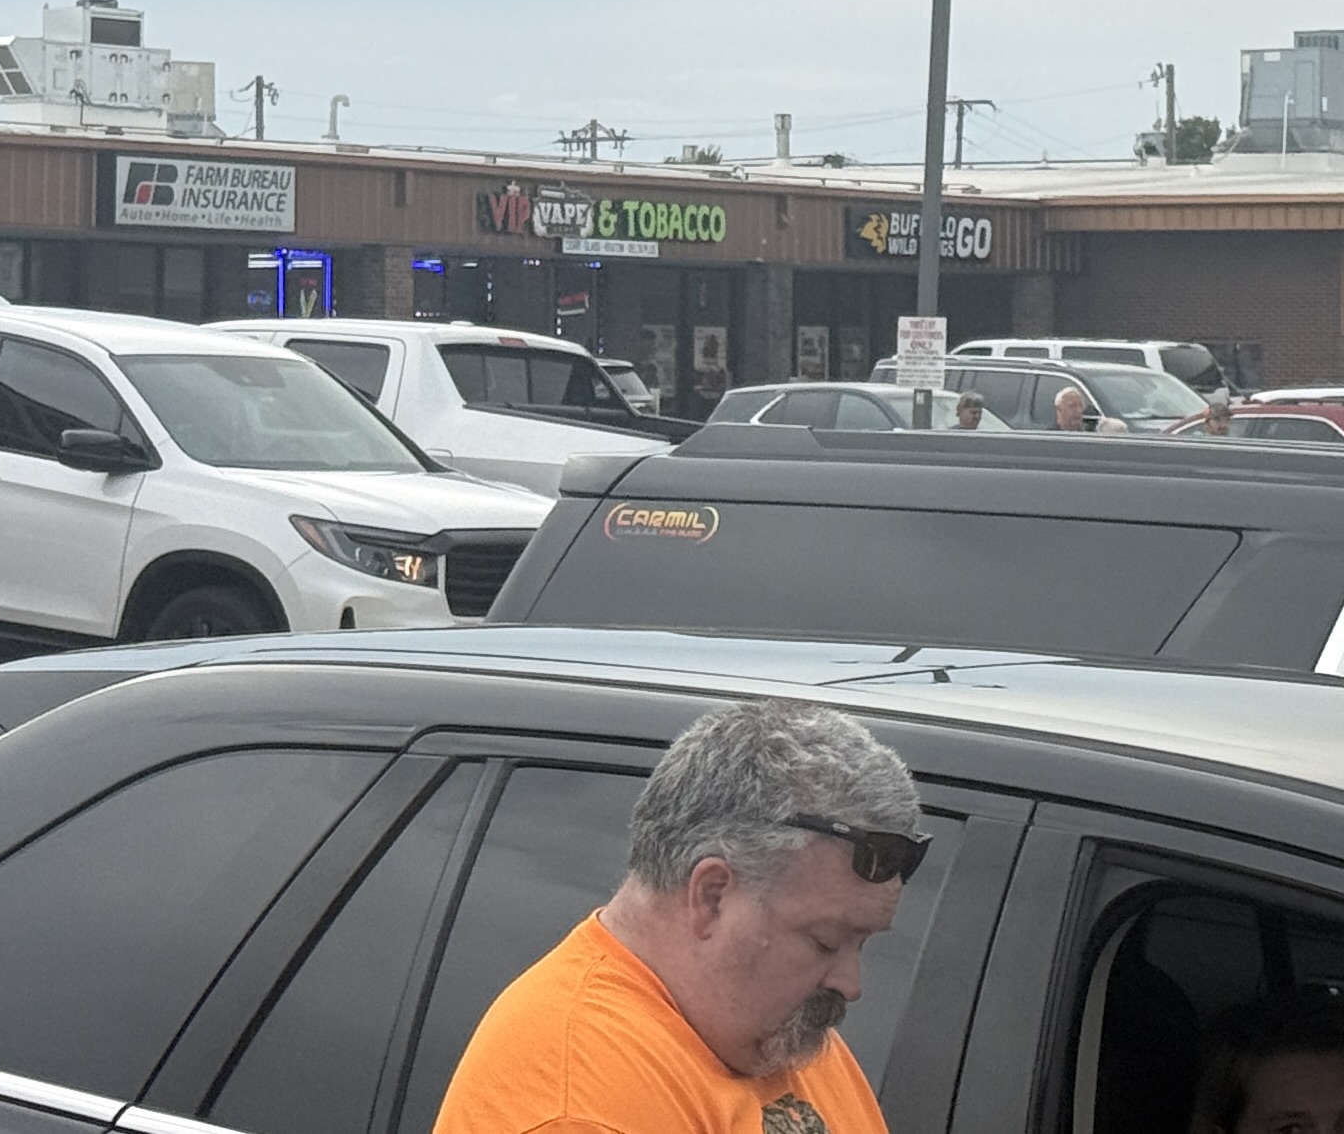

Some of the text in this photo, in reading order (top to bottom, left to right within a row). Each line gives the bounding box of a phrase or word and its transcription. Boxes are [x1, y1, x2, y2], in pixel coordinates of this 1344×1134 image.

[185, 165, 292, 191] FARM BUREAU
[181, 188, 288, 213] INSURANCE
[120, 208, 283, 227] Auto Home Life Health
[488, 194, 727, 243] VIP VAPE & TOBACCO
[888, 237, 918, 256] WILD
[956, 217, 992, 259] GO
[616, 509, 706, 530] CARMIL
